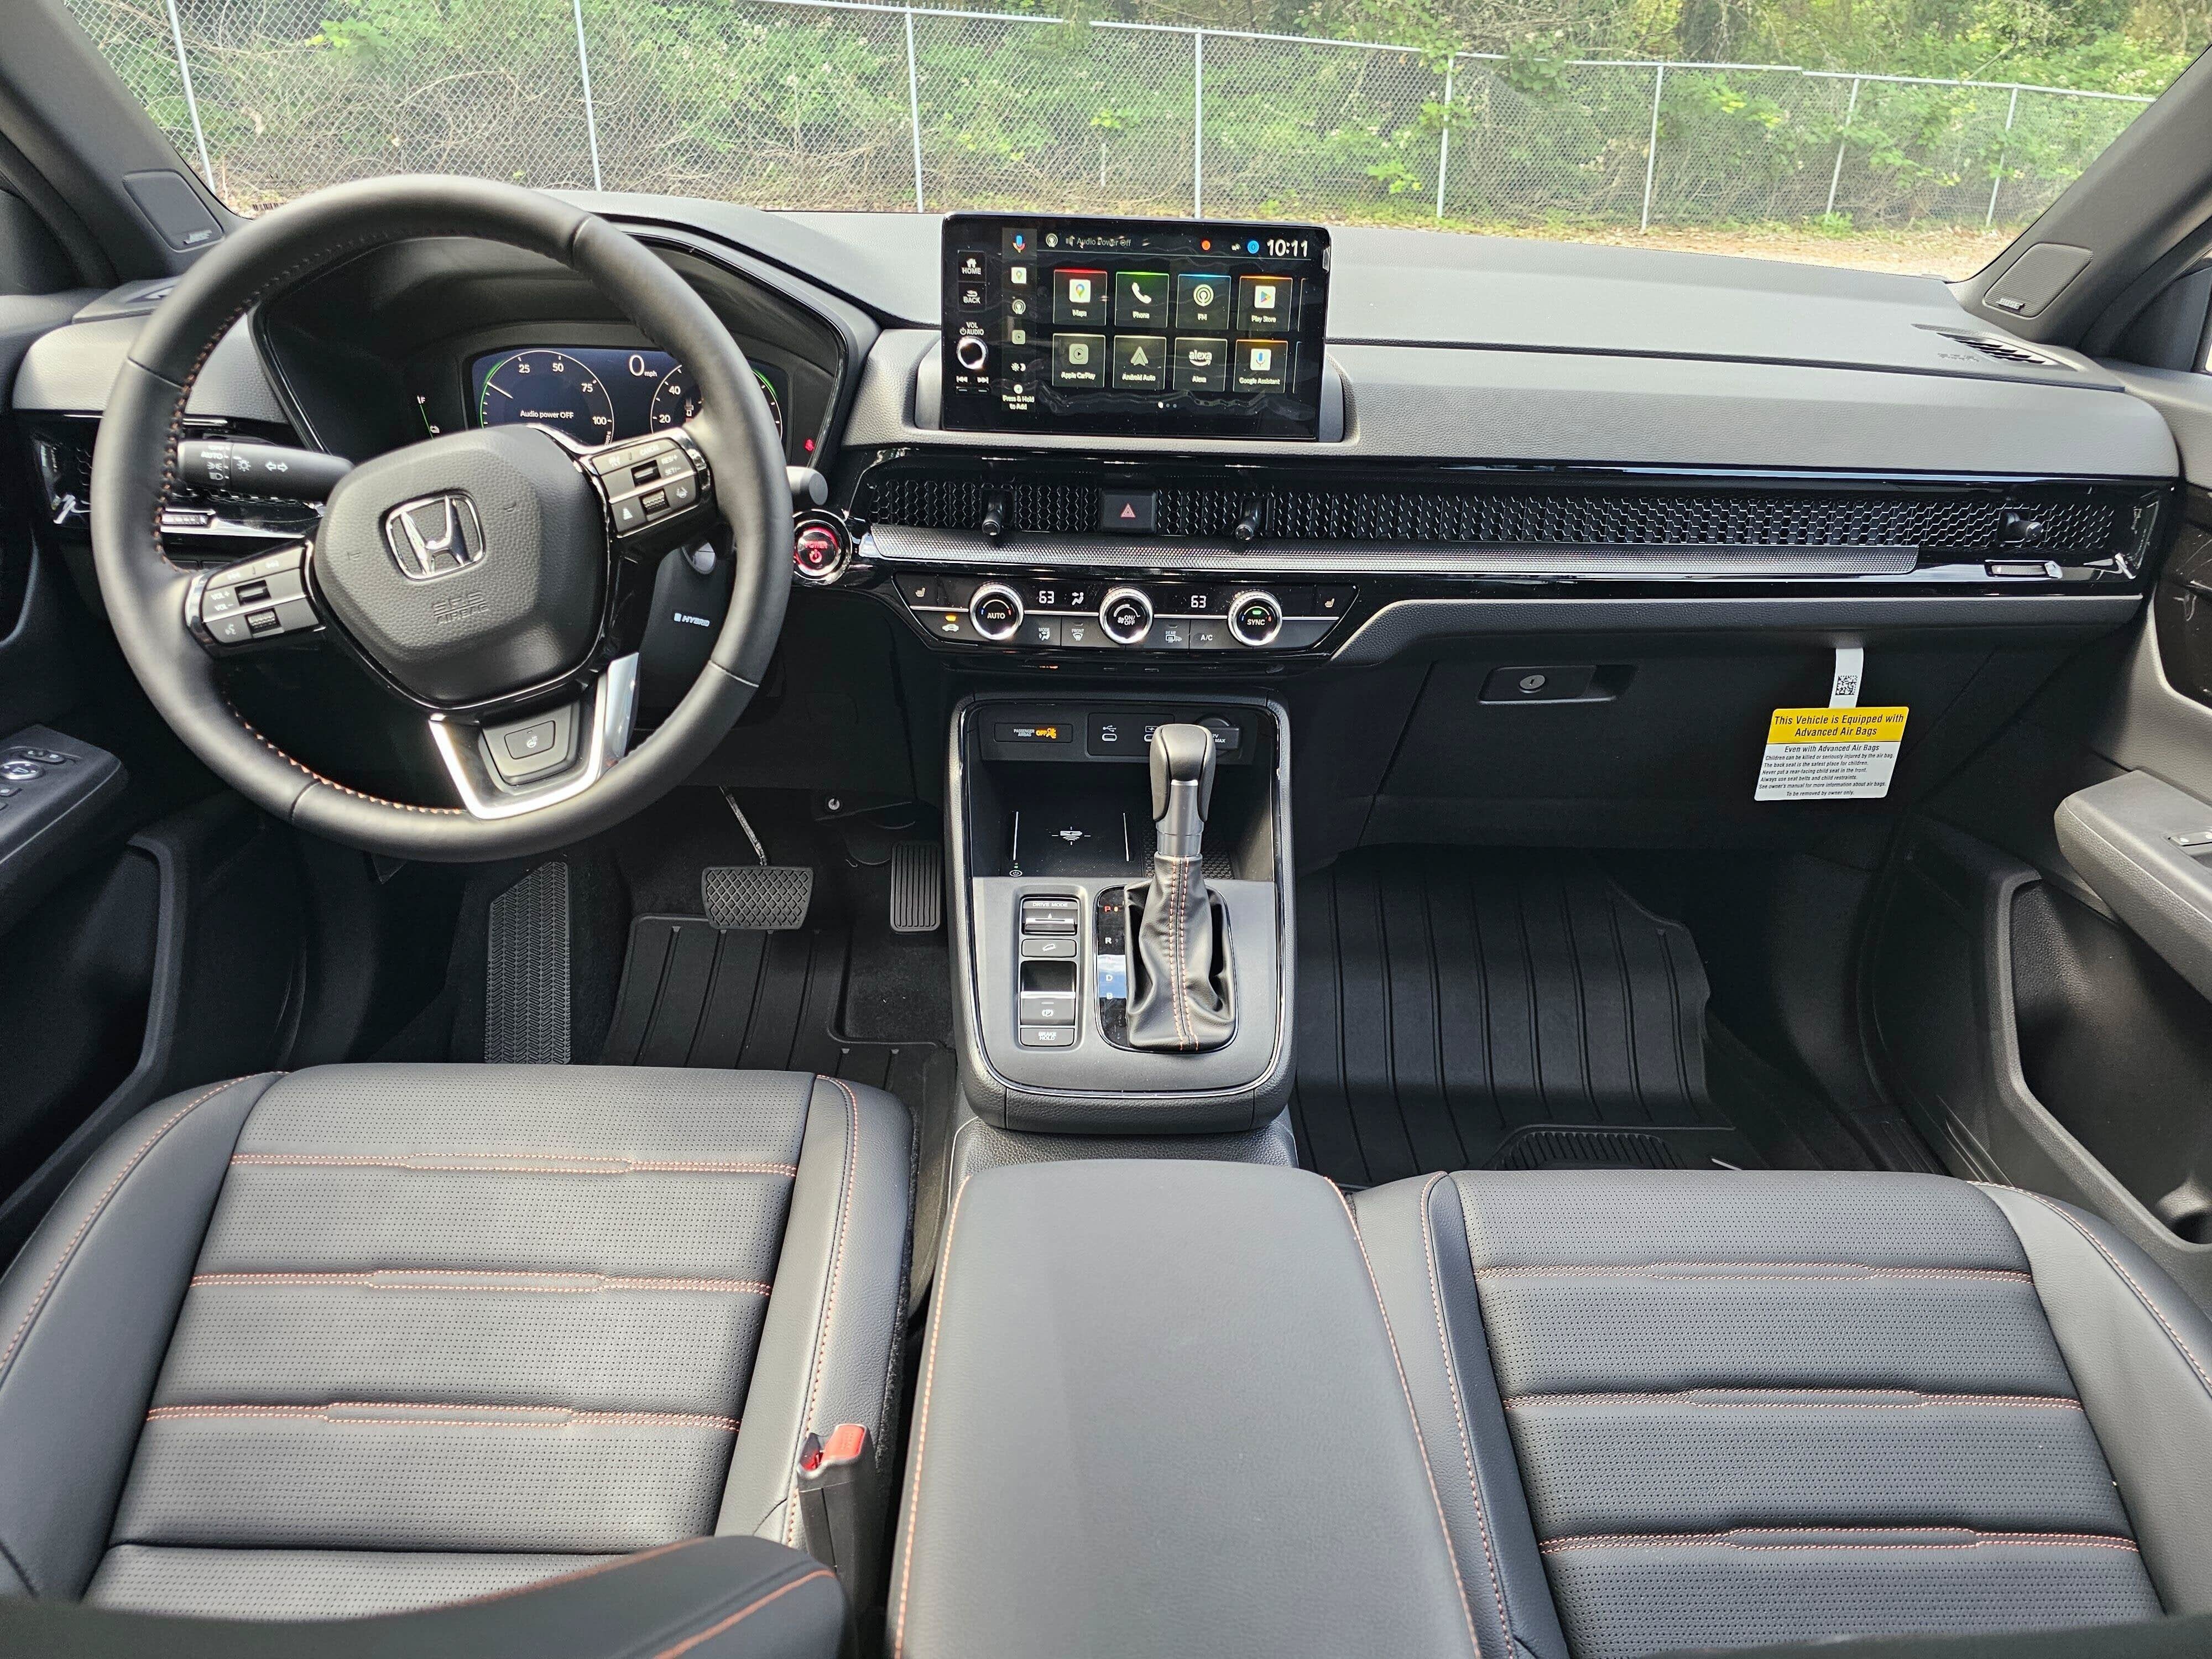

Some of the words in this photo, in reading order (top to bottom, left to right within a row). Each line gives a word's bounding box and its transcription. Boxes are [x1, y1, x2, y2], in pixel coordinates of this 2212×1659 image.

[1077, 238, 1096, 246] Audio
[1097, 237, 1118, 247] Power
[1119, 238, 1131, 247] Off
[1267, 239, 1308, 257] 10:11
[962, 296, 980, 304] BACK
[1132, 311, 1150, 319] Phone
[1251, 315, 1262, 324] Play
[1189, 349, 1212, 361] alexa
[518, 363, 530, 373] 25
[552, 363, 564, 372] 50
[629, 354, 645, 377] 0
[1061, 372, 1076, 380] Apple
[1076, 372, 1096, 380] CarPlay
[1121, 372, 1142, 381] Android
[1239, 377, 1257, 385] Google
[581, 383, 593, 393] 75
[668, 385, 681, 395] 40
[1002, 394, 1016, 403] Press
[520, 410, 539, 418] Audio
[539, 411, 560, 419] power
[659, 414, 671, 423] 20
[592, 416, 607, 426] 100
[639, 444, 660, 456] CANCEL
[201, 451, 223, 460] AUTO
[805, 540, 828, 549] POWER
[1039, 590, 1055, 604] 63
[1191, 595, 1207, 608] 63
[681, 615, 710, 627] HYBRID
[1775, 716, 1793, 725] This
[1797, 715, 1828, 724] Vehicle
[1831, 715, 1839, 724] is
[1841, 714, 1882, 725] Equipped
[1885, 714, 1904, 723] with
[1794, 727, 1838, 737] Advanced
[1840, 727, 1854, 735] Air
[1855, 727, 1877, 737] Bags
